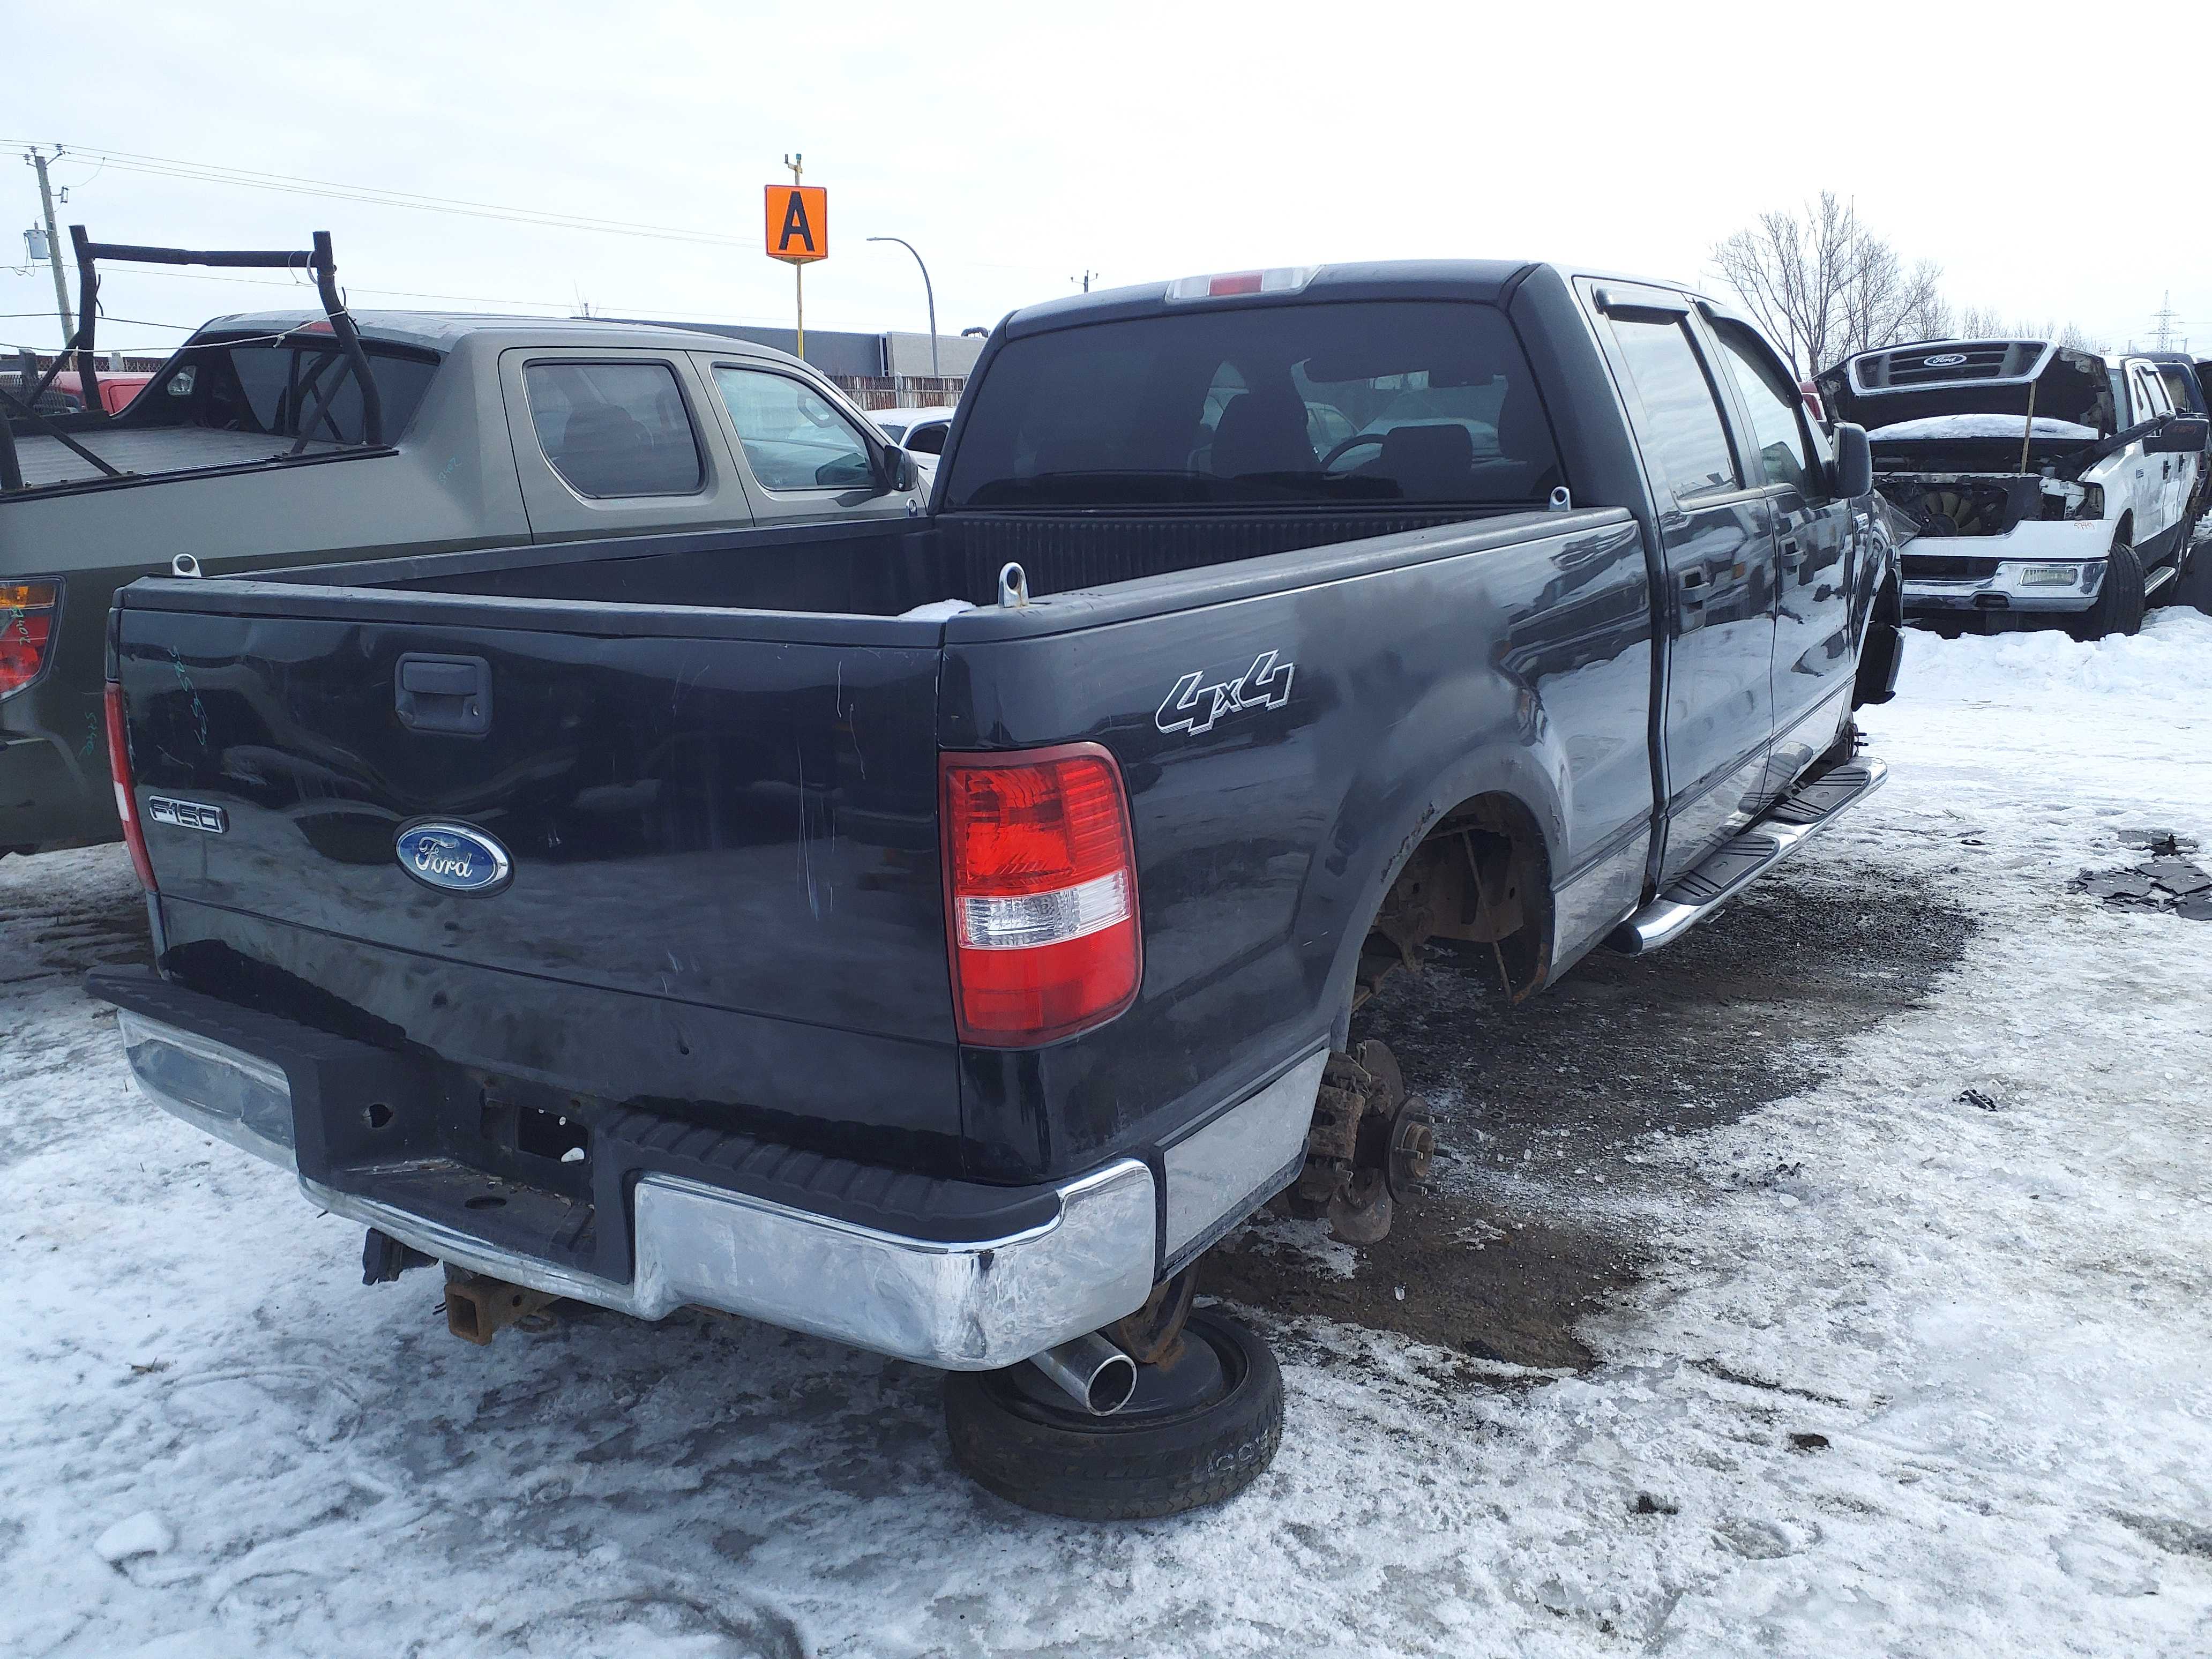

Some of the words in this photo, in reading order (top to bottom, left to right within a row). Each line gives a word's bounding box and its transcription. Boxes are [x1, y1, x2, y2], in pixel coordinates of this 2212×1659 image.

[778, 190, 815, 251] A
[1155, 648, 1295, 736] 4x4
[415, 836, 473, 878] Ford
